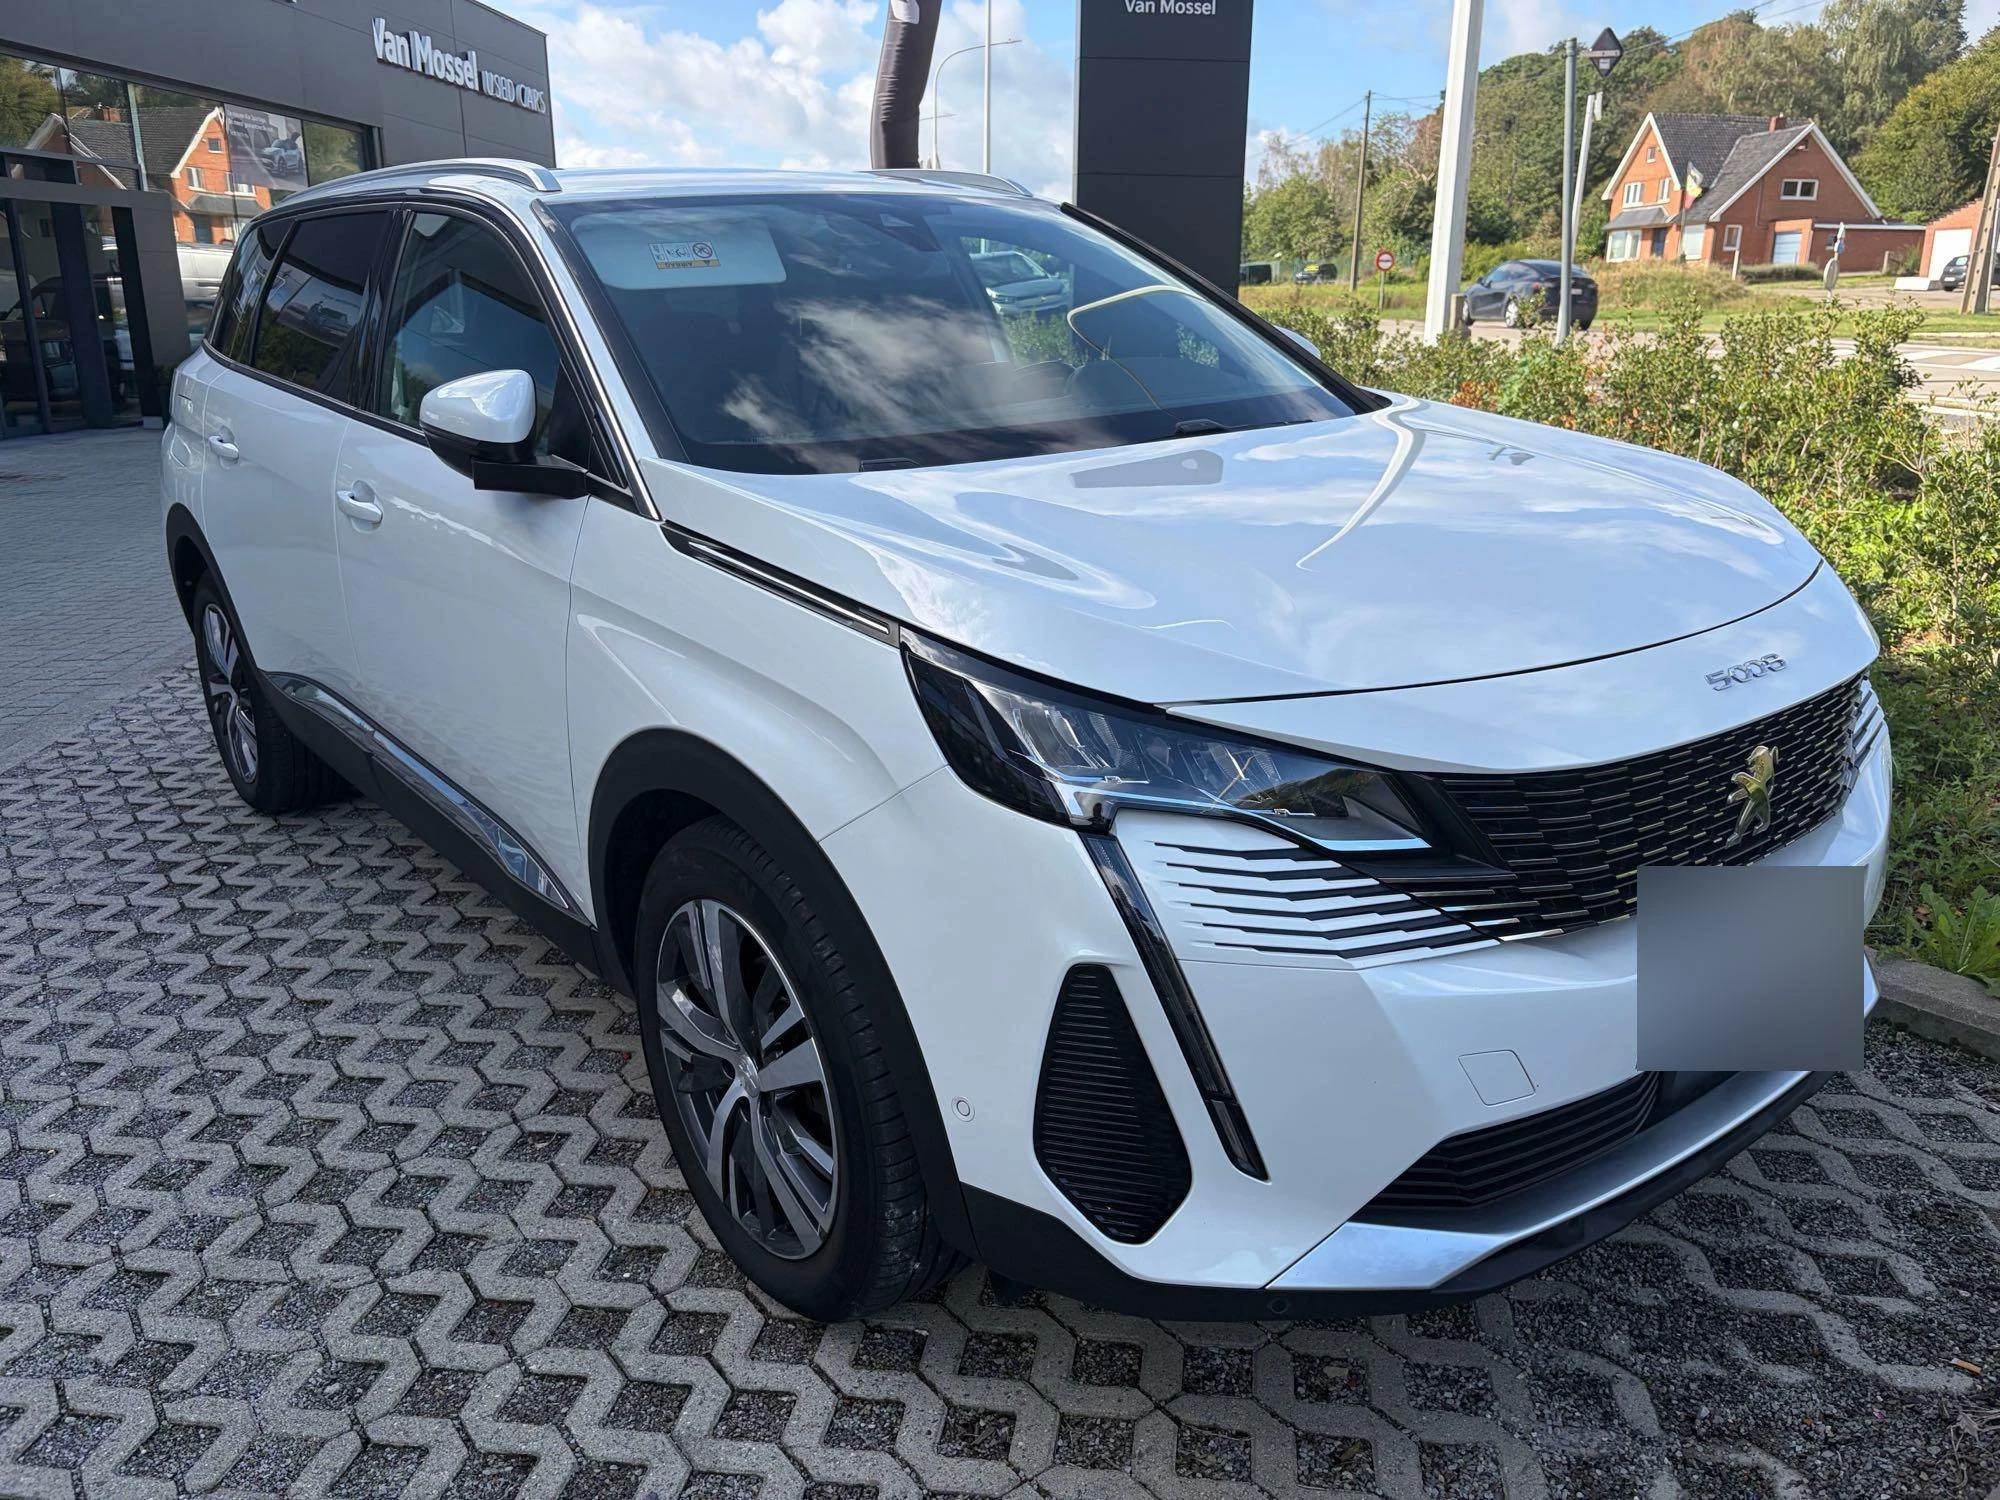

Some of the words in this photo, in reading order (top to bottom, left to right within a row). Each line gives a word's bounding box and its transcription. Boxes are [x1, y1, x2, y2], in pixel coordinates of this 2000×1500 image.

[1124, 0, 1156, 13] Van
[1160, 0, 1217, 15] Mossel
[372, 17, 411, 67] Van
[409, 31, 480, 91] Mossel
[481, 70, 515, 103] USED
[516, 83, 546, 114] CARS
[1705, 653, 1787, 692] 5008
